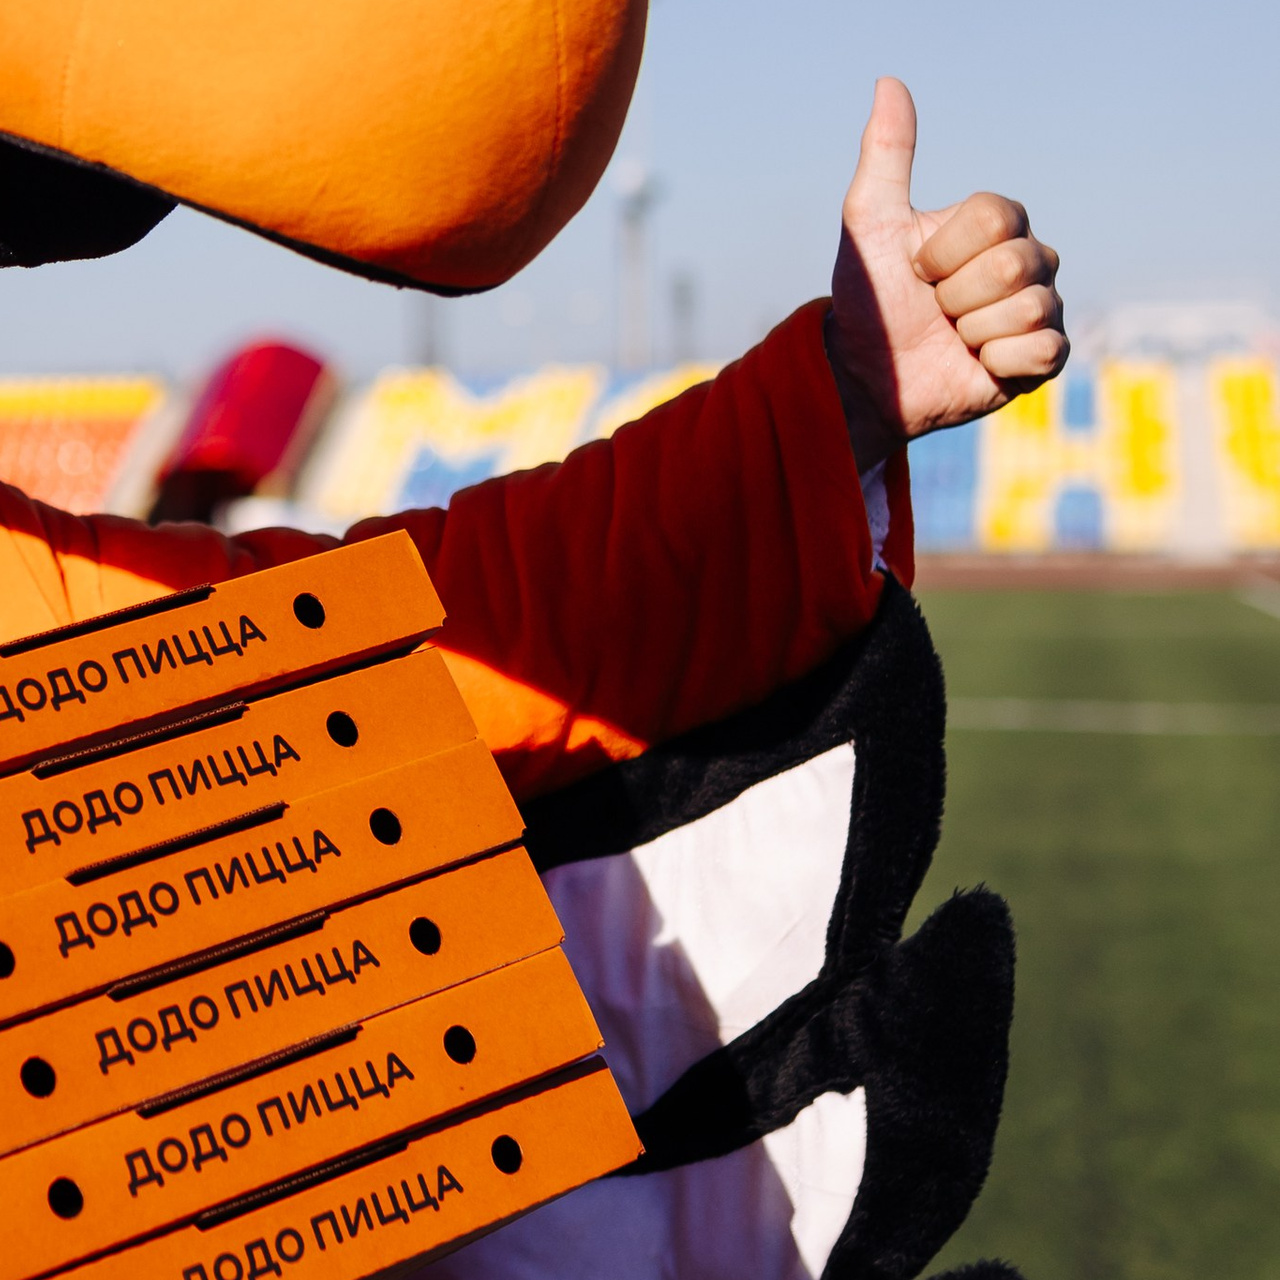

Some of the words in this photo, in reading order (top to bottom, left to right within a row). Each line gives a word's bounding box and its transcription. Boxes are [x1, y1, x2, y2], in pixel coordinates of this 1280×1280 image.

[112, 615, 267, 684] ПИЦЦА
[21, 781, 144, 854] ДОДО
[147, 734, 301, 805] ПИЦЦА
[54, 882, 180, 958] ДОДО
[184, 829, 341, 905] ПИЦЦА
[95, 995, 219, 1075] ДОДО
[224, 939, 381, 1019] ПИЦЦА
[125, 1113, 251, 1197] ДОДО
[256, 1052, 415, 1136] ПИЦЦА
[310, 1165, 464, 1251] ПИЦЦА
